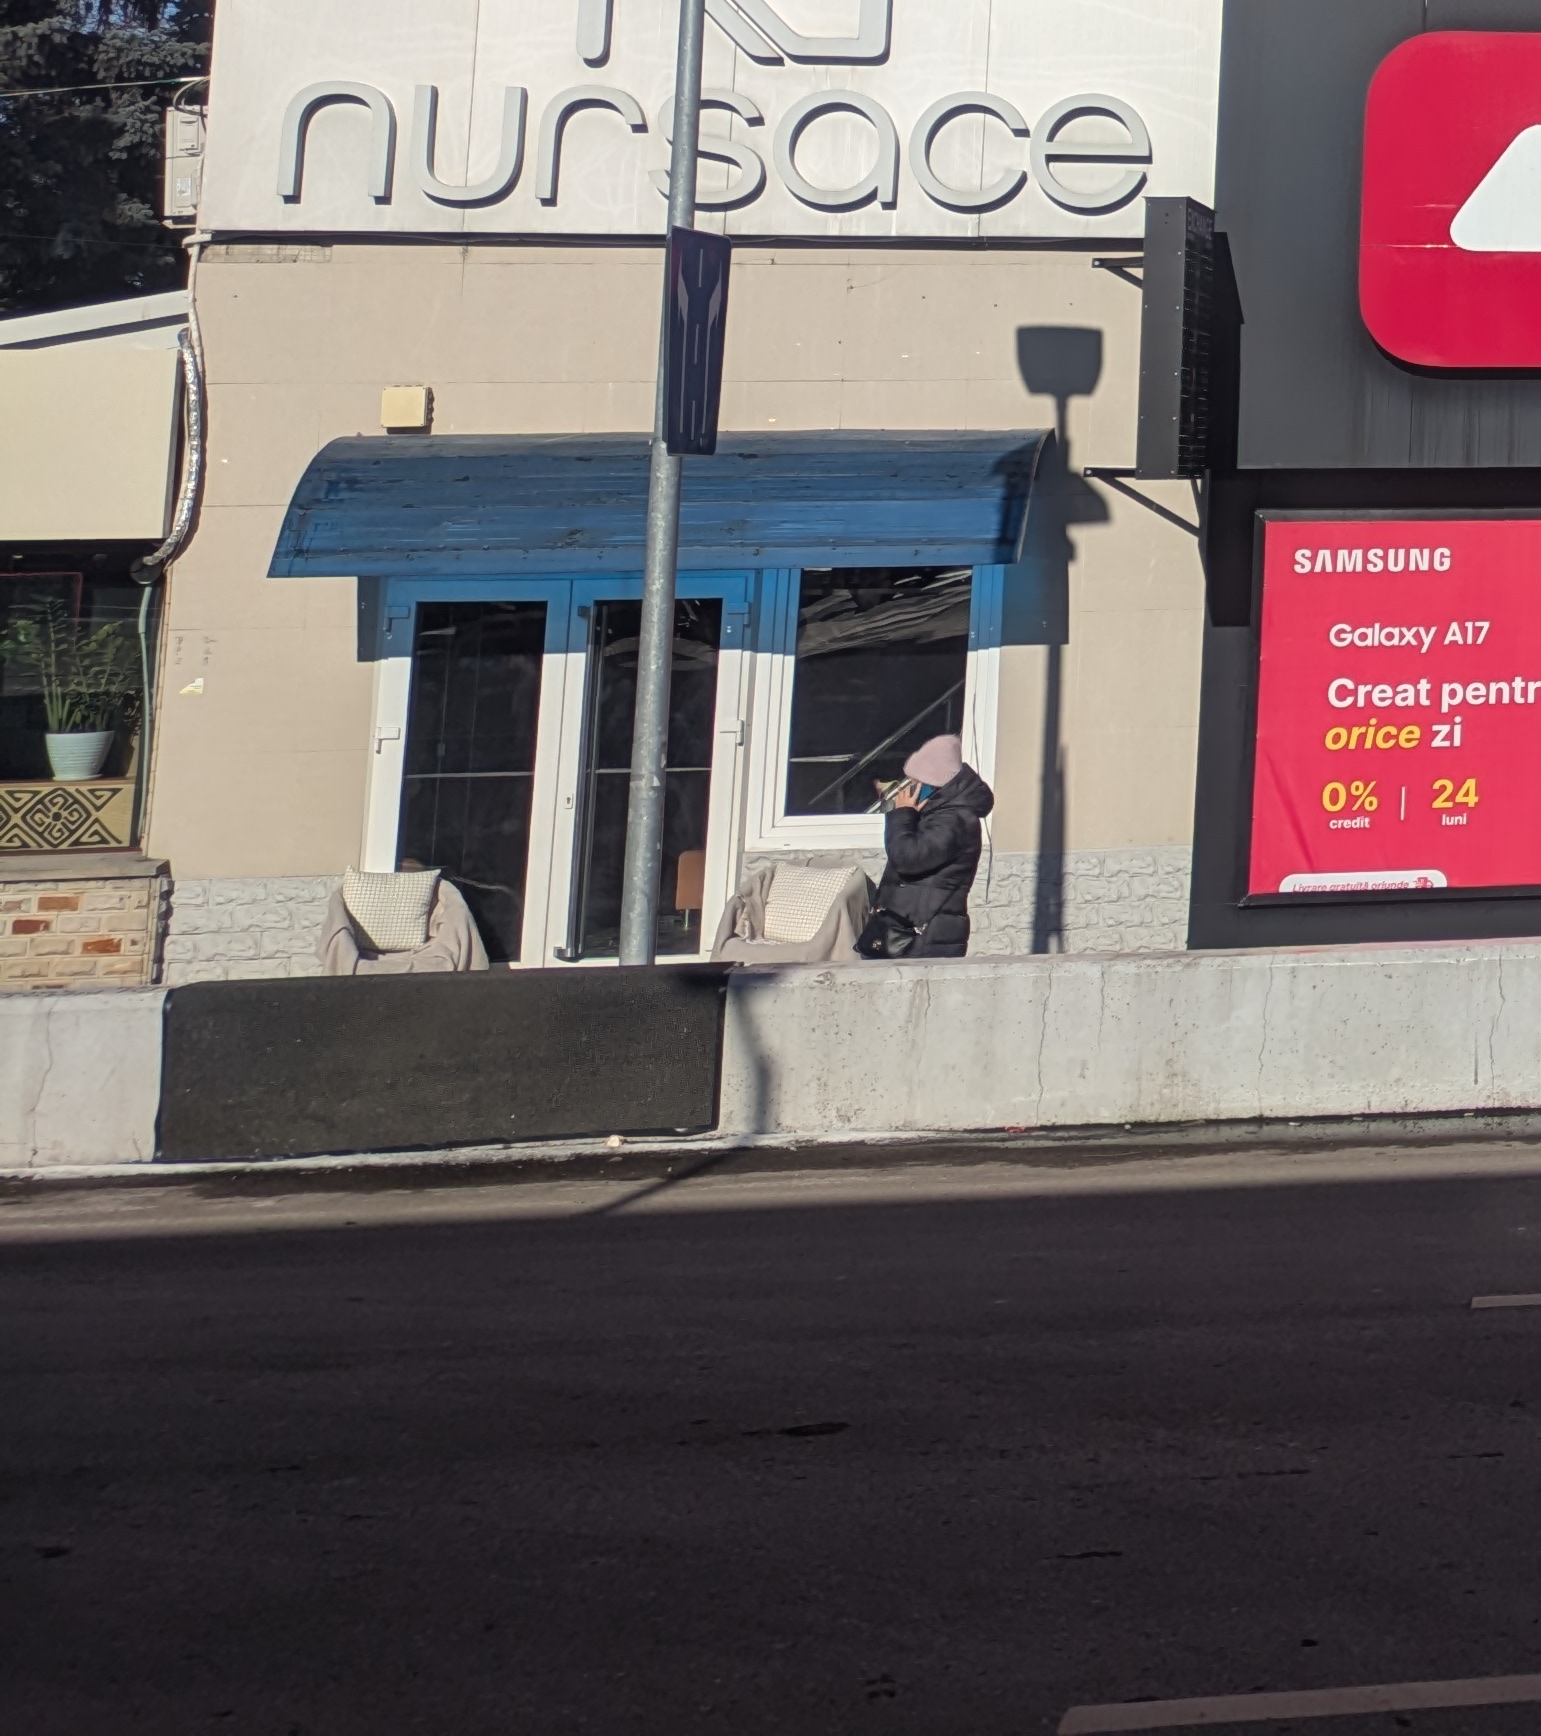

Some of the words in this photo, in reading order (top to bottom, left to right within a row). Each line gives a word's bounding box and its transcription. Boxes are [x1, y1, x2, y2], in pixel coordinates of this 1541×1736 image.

[276, 80, 1153, 215] nursace
[1293, 547, 1451, 574] SAMSUNG
[1328, 621, 1437, 654] Galaxy
[1442, 621, 1490, 647] A17
[1327, 677, 1431, 710] Creat
[1324, 715, 1422, 751] orice
[1430, 715, 1463, 749] zi
[1321, 780, 1379, 813] 0%
[1430, 778, 1480, 810] 24
[1329, 815, 1371, 831] credit
[1441, 811, 1468, 827] luni
